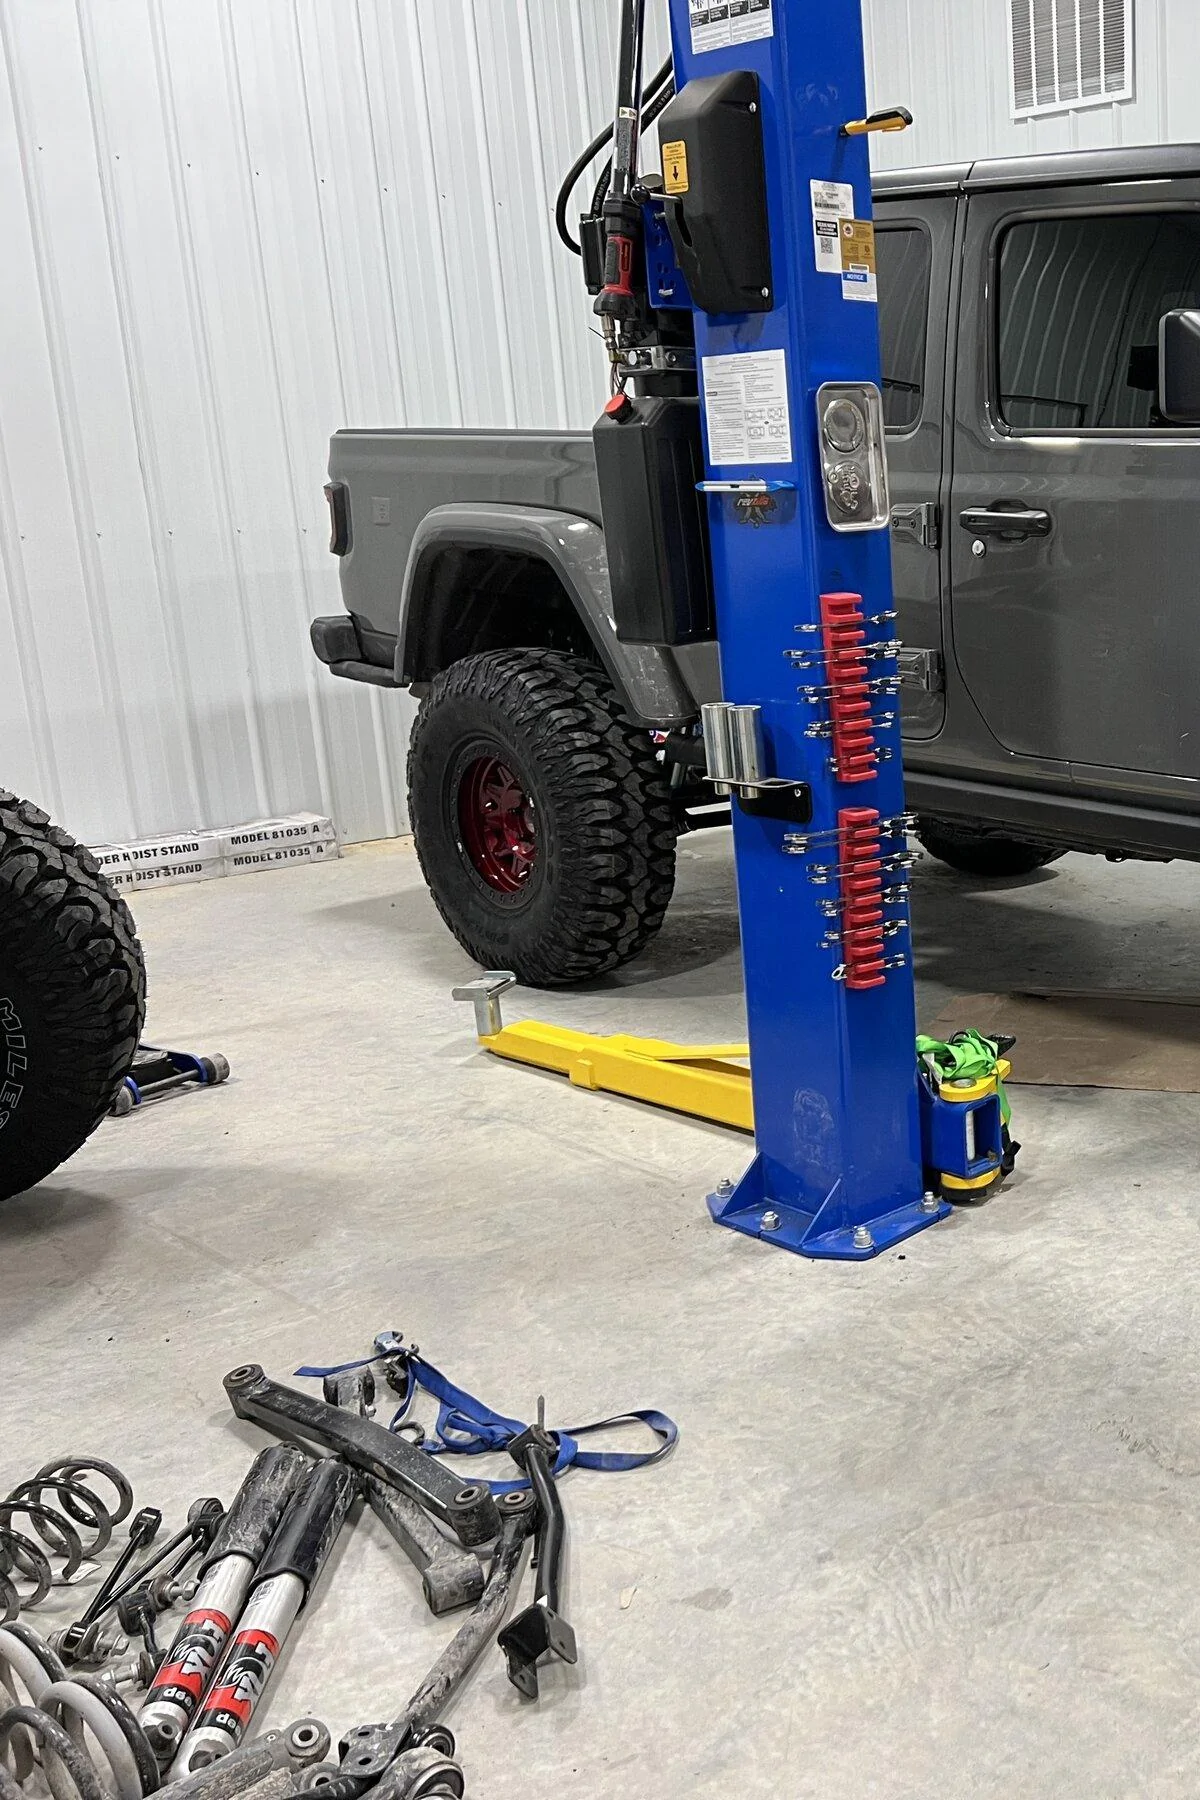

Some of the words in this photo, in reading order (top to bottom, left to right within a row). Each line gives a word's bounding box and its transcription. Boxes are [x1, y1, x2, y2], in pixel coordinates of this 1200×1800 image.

[846, 273, 864, 282] NOTICE
[160, 843, 199, 856] STAND
[231, 832, 270, 845] MODEL
[272, 827, 307, 839] 81035
[312, 825, 320, 833] A
[161, 864, 202, 876] STAND
[233, 853, 273, 866] MODEL
[275, 847, 310, 860] 81035
[316, 845, 324, 853] A
